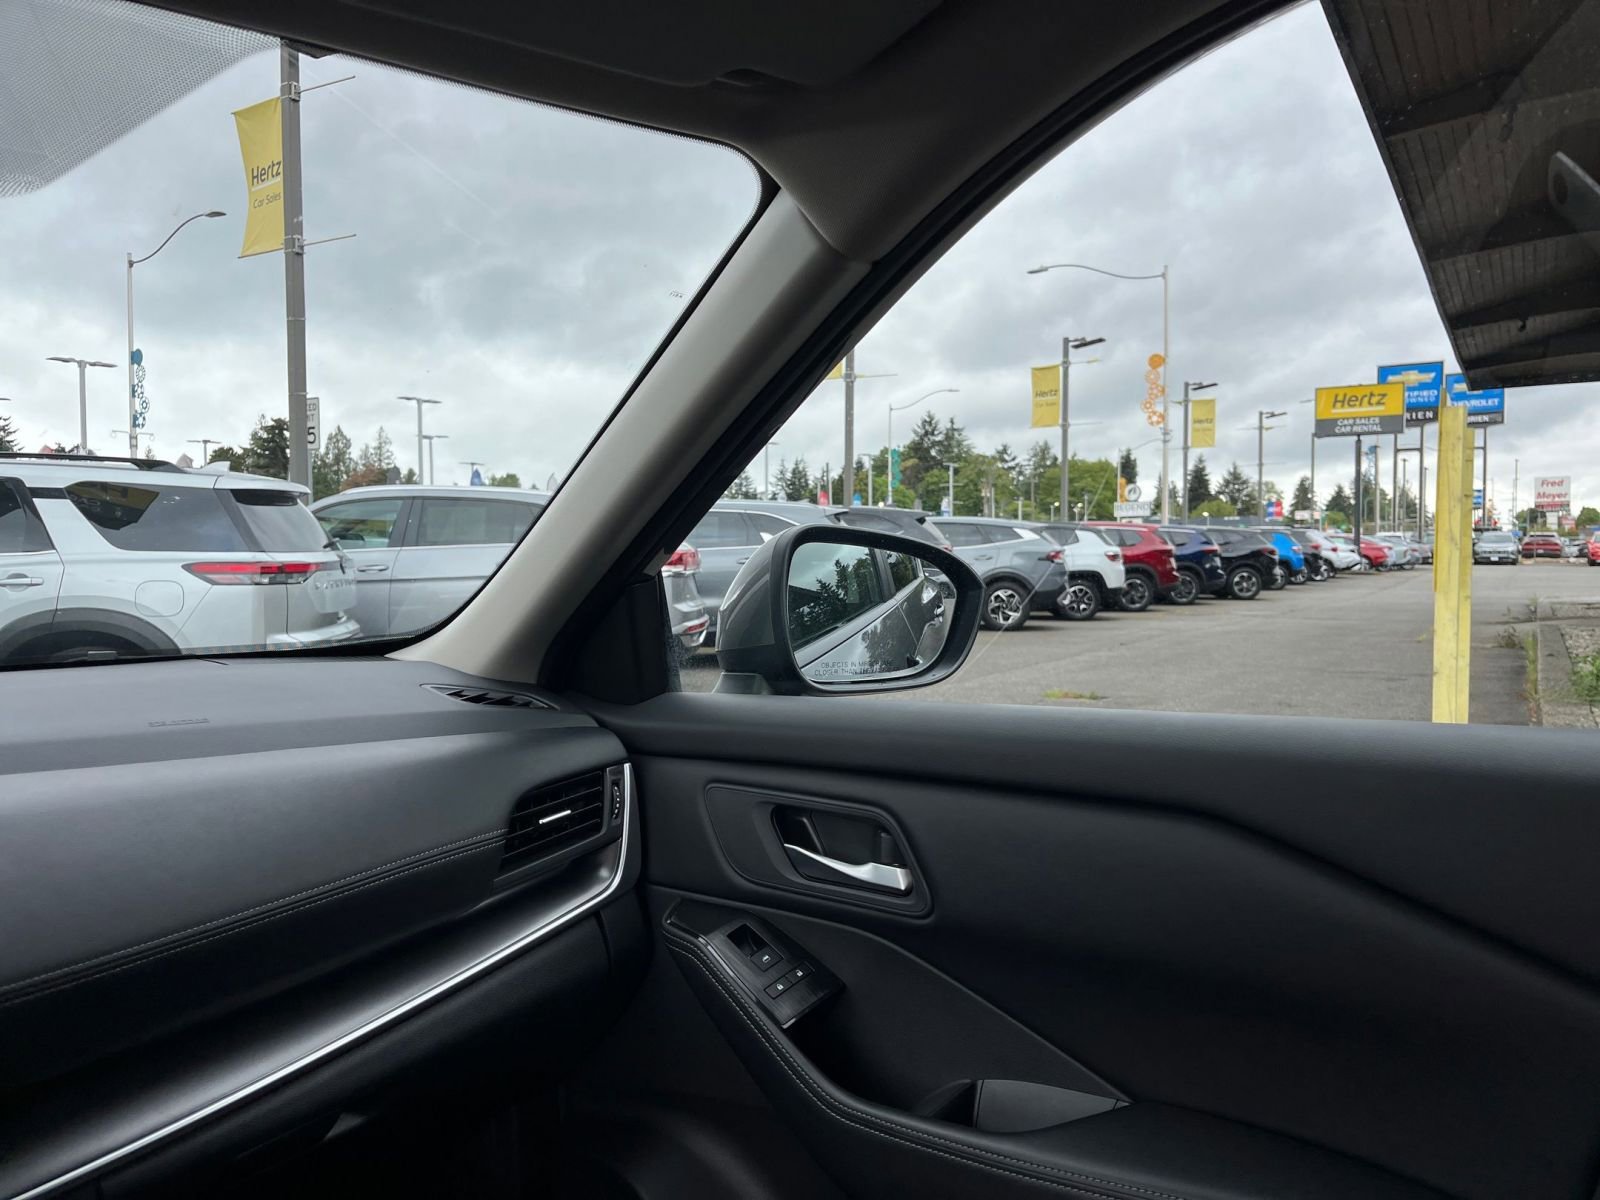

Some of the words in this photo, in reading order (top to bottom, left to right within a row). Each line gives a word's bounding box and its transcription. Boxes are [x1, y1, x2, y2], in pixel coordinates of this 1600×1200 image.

[251, 160, 282, 186] Hertz
[253, 198, 265, 209] Car
[265, 192, 282, 206] Sales
[1332, 390, 1388, 409] Hertz
[1337, 418, 1354, 426] CAR
[1354, 416, 1380, 425] SALES
[1335, 425, 1352, 434] CAR
[1352, 424, 1383, 433] RENTAL
[1541, 479, 1565, 488] Fred
[1536, 491, 1569, 501] Meyer
[821, 661, 849, 669] OBJECTS
